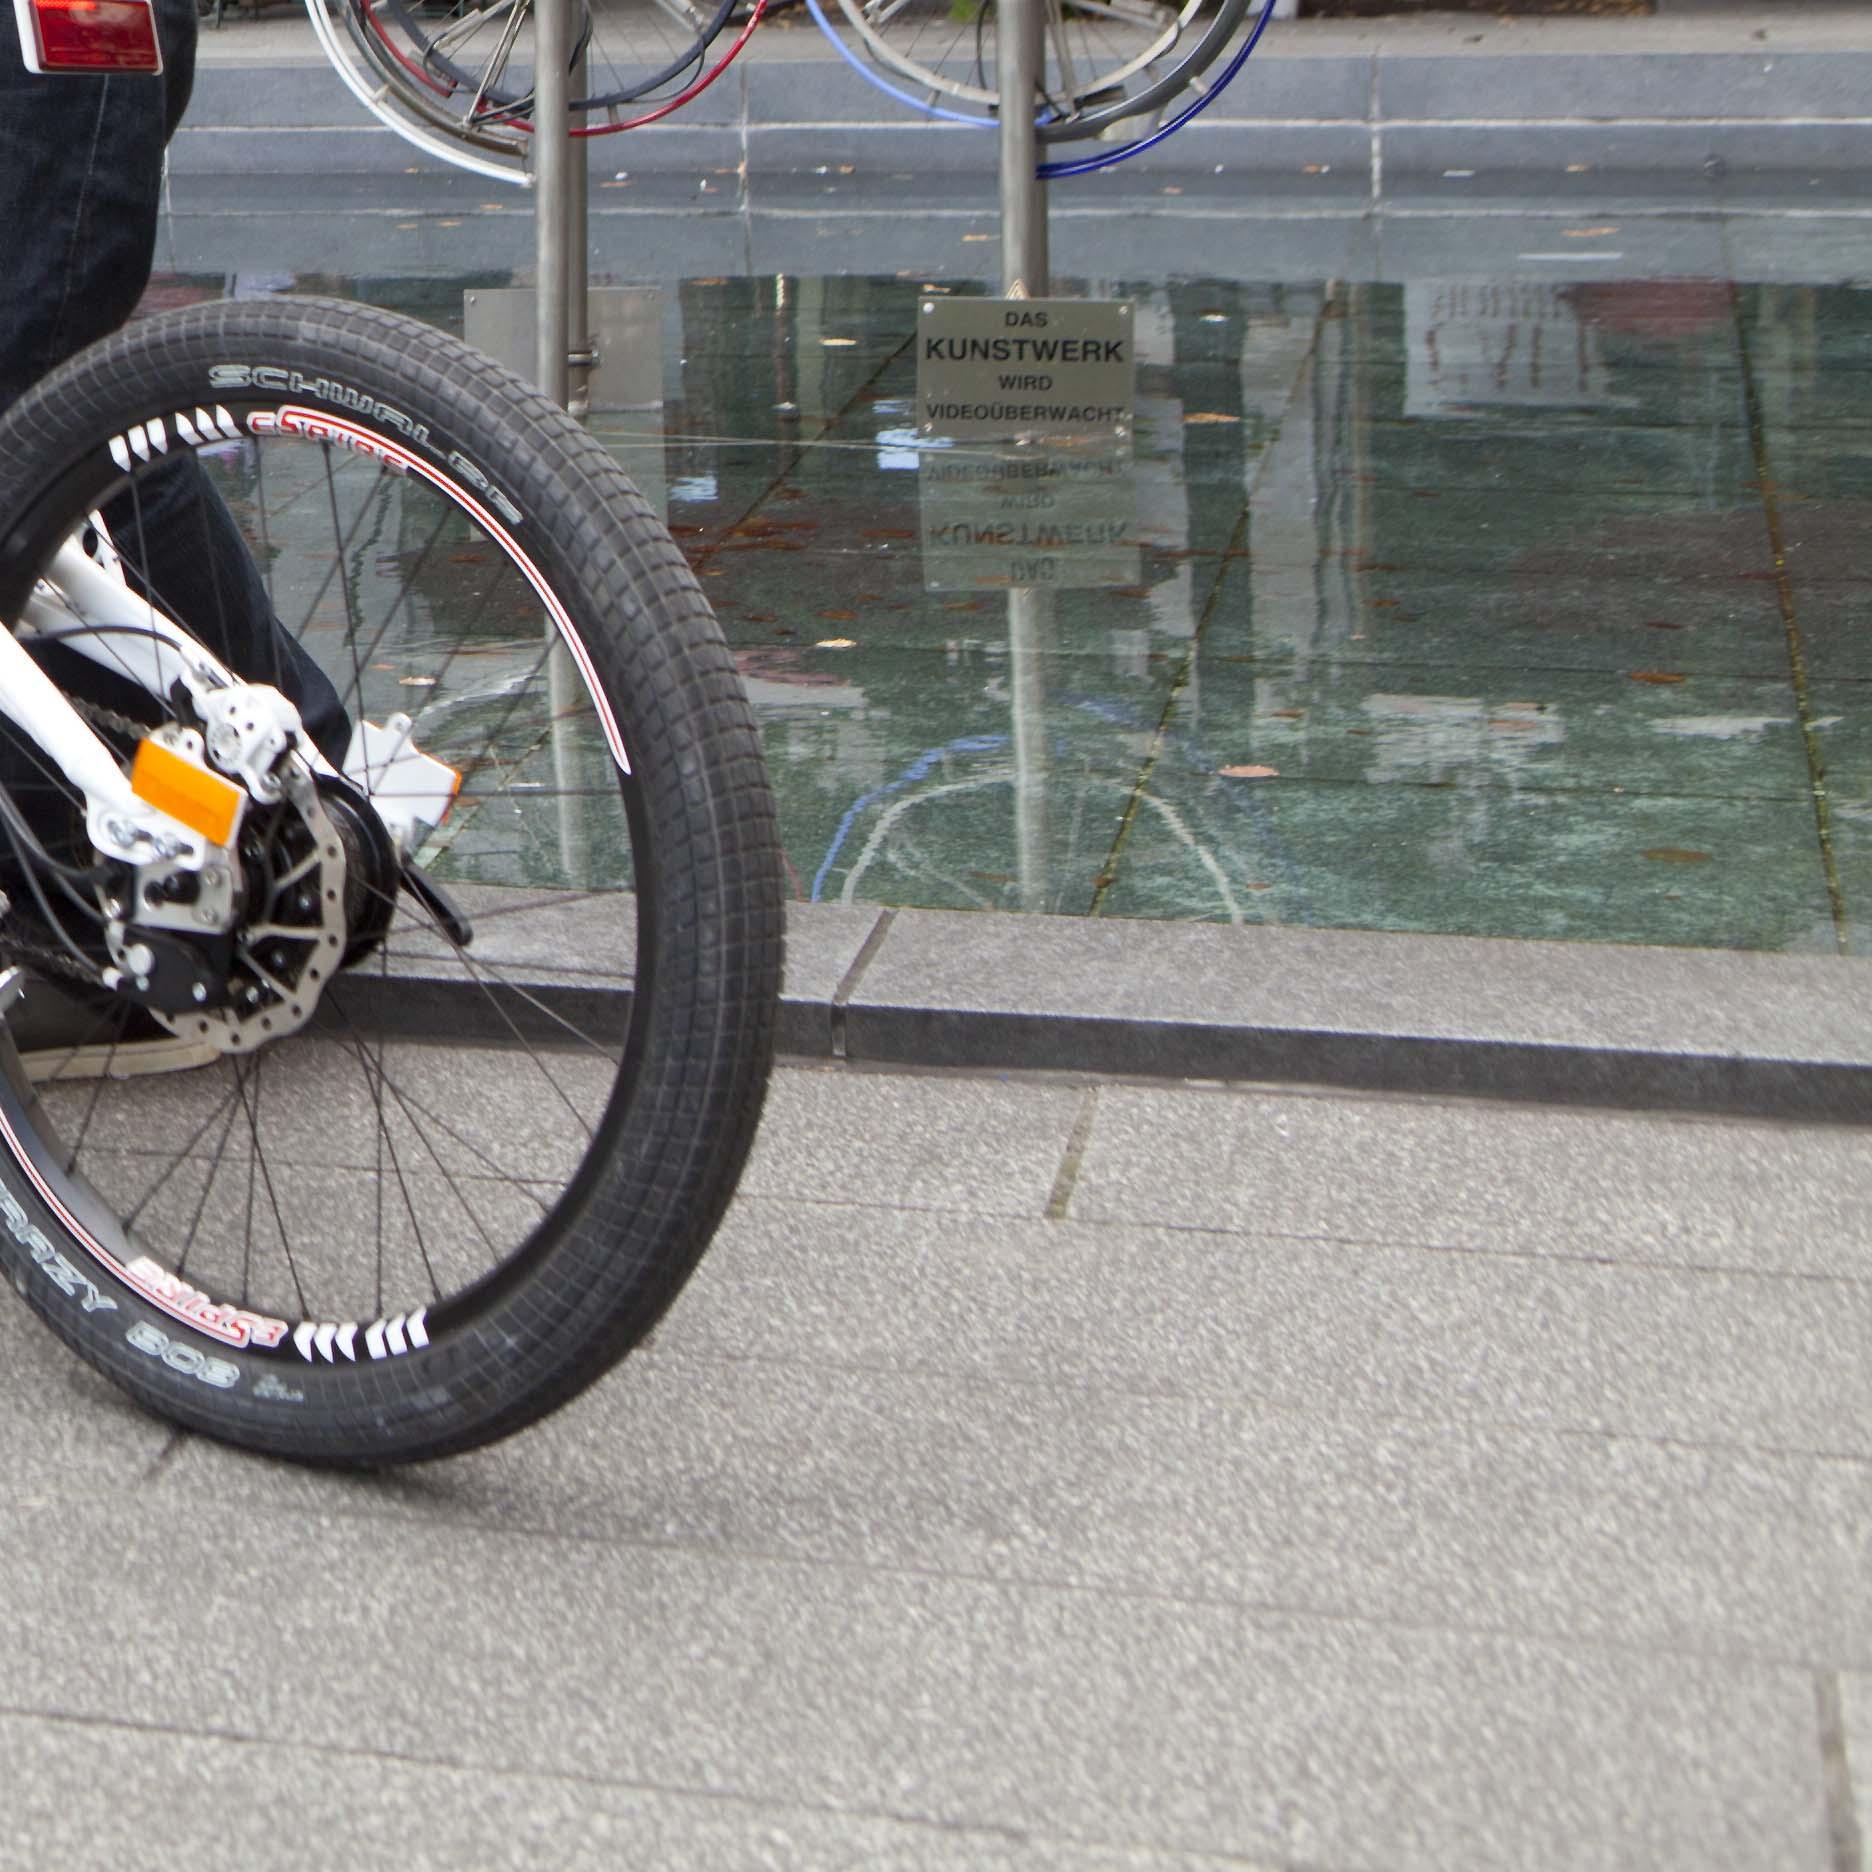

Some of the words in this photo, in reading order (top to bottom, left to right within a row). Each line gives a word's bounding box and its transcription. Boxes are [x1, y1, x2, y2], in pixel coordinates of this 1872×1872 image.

[1005, 311, 1049, 328] DAS
[925, 337, 1125, 364] KUNSTWERK
[998, 375, 1053, 392] WIRD
[927, 403, 1125, 423] VIDEOÜBERWACHT
[208, 364, 523, 525] SCHWALBE
[125, 1320, 241, 1389] BOB
